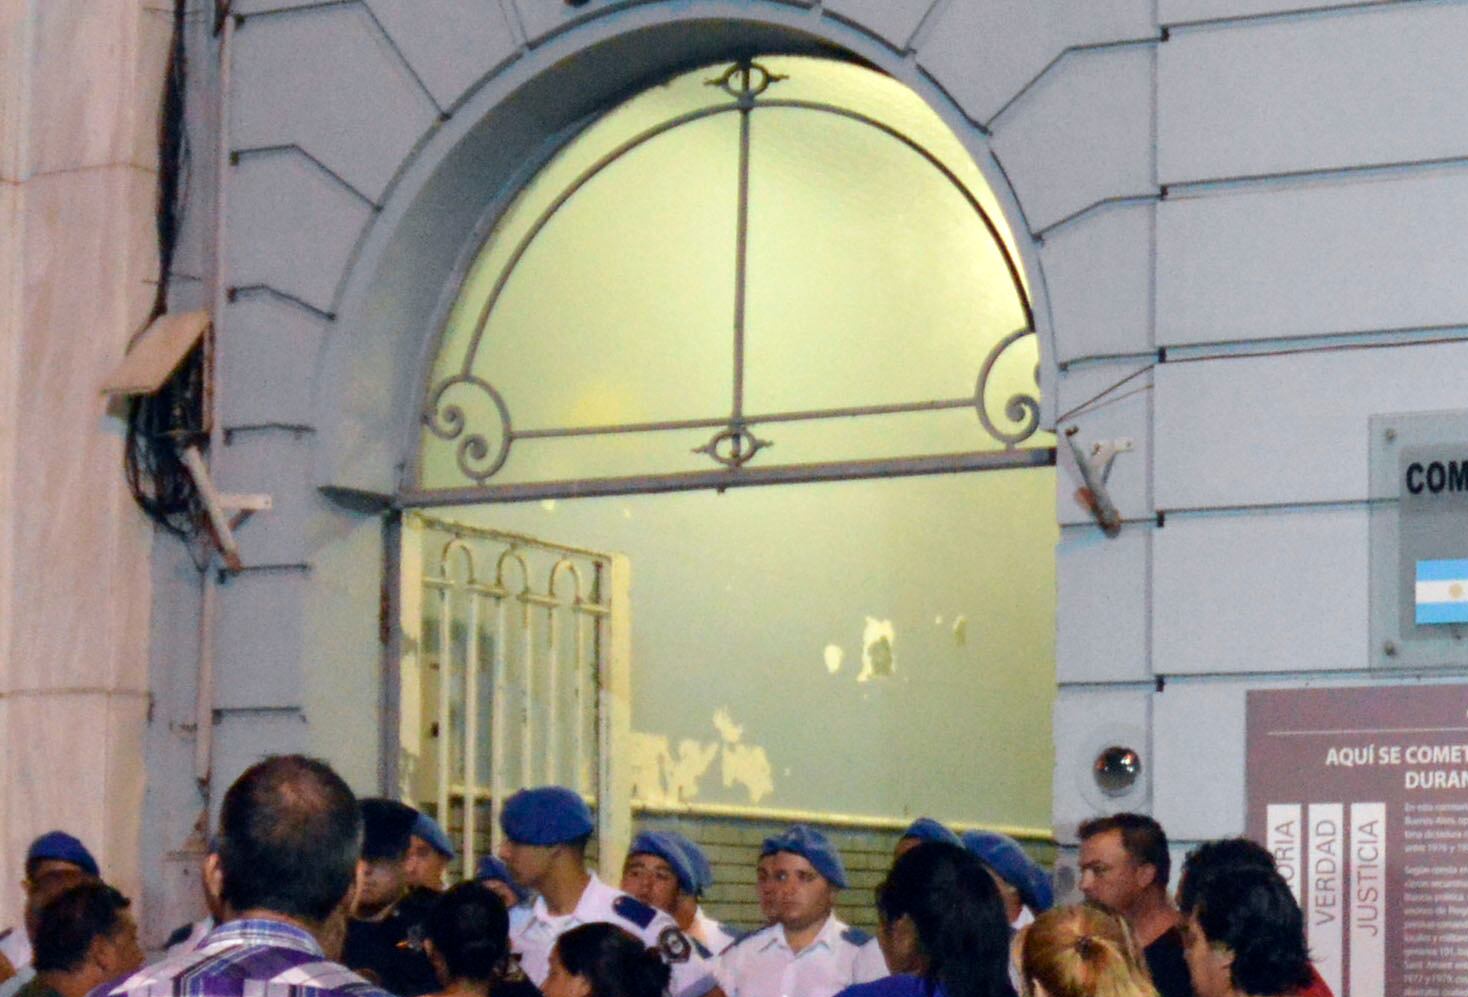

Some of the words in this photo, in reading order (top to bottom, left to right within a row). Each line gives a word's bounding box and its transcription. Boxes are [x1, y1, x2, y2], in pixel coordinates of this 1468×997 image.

[1326, 744, 1374, 766] AQUÍ
[1379, 747, 1401, 764] SE
[1275, 820, 1296, 886] ORIA
[1316, 819, 1336, 926] VERDAD
[1357, 820, 1379, 937] JUSTICIA
